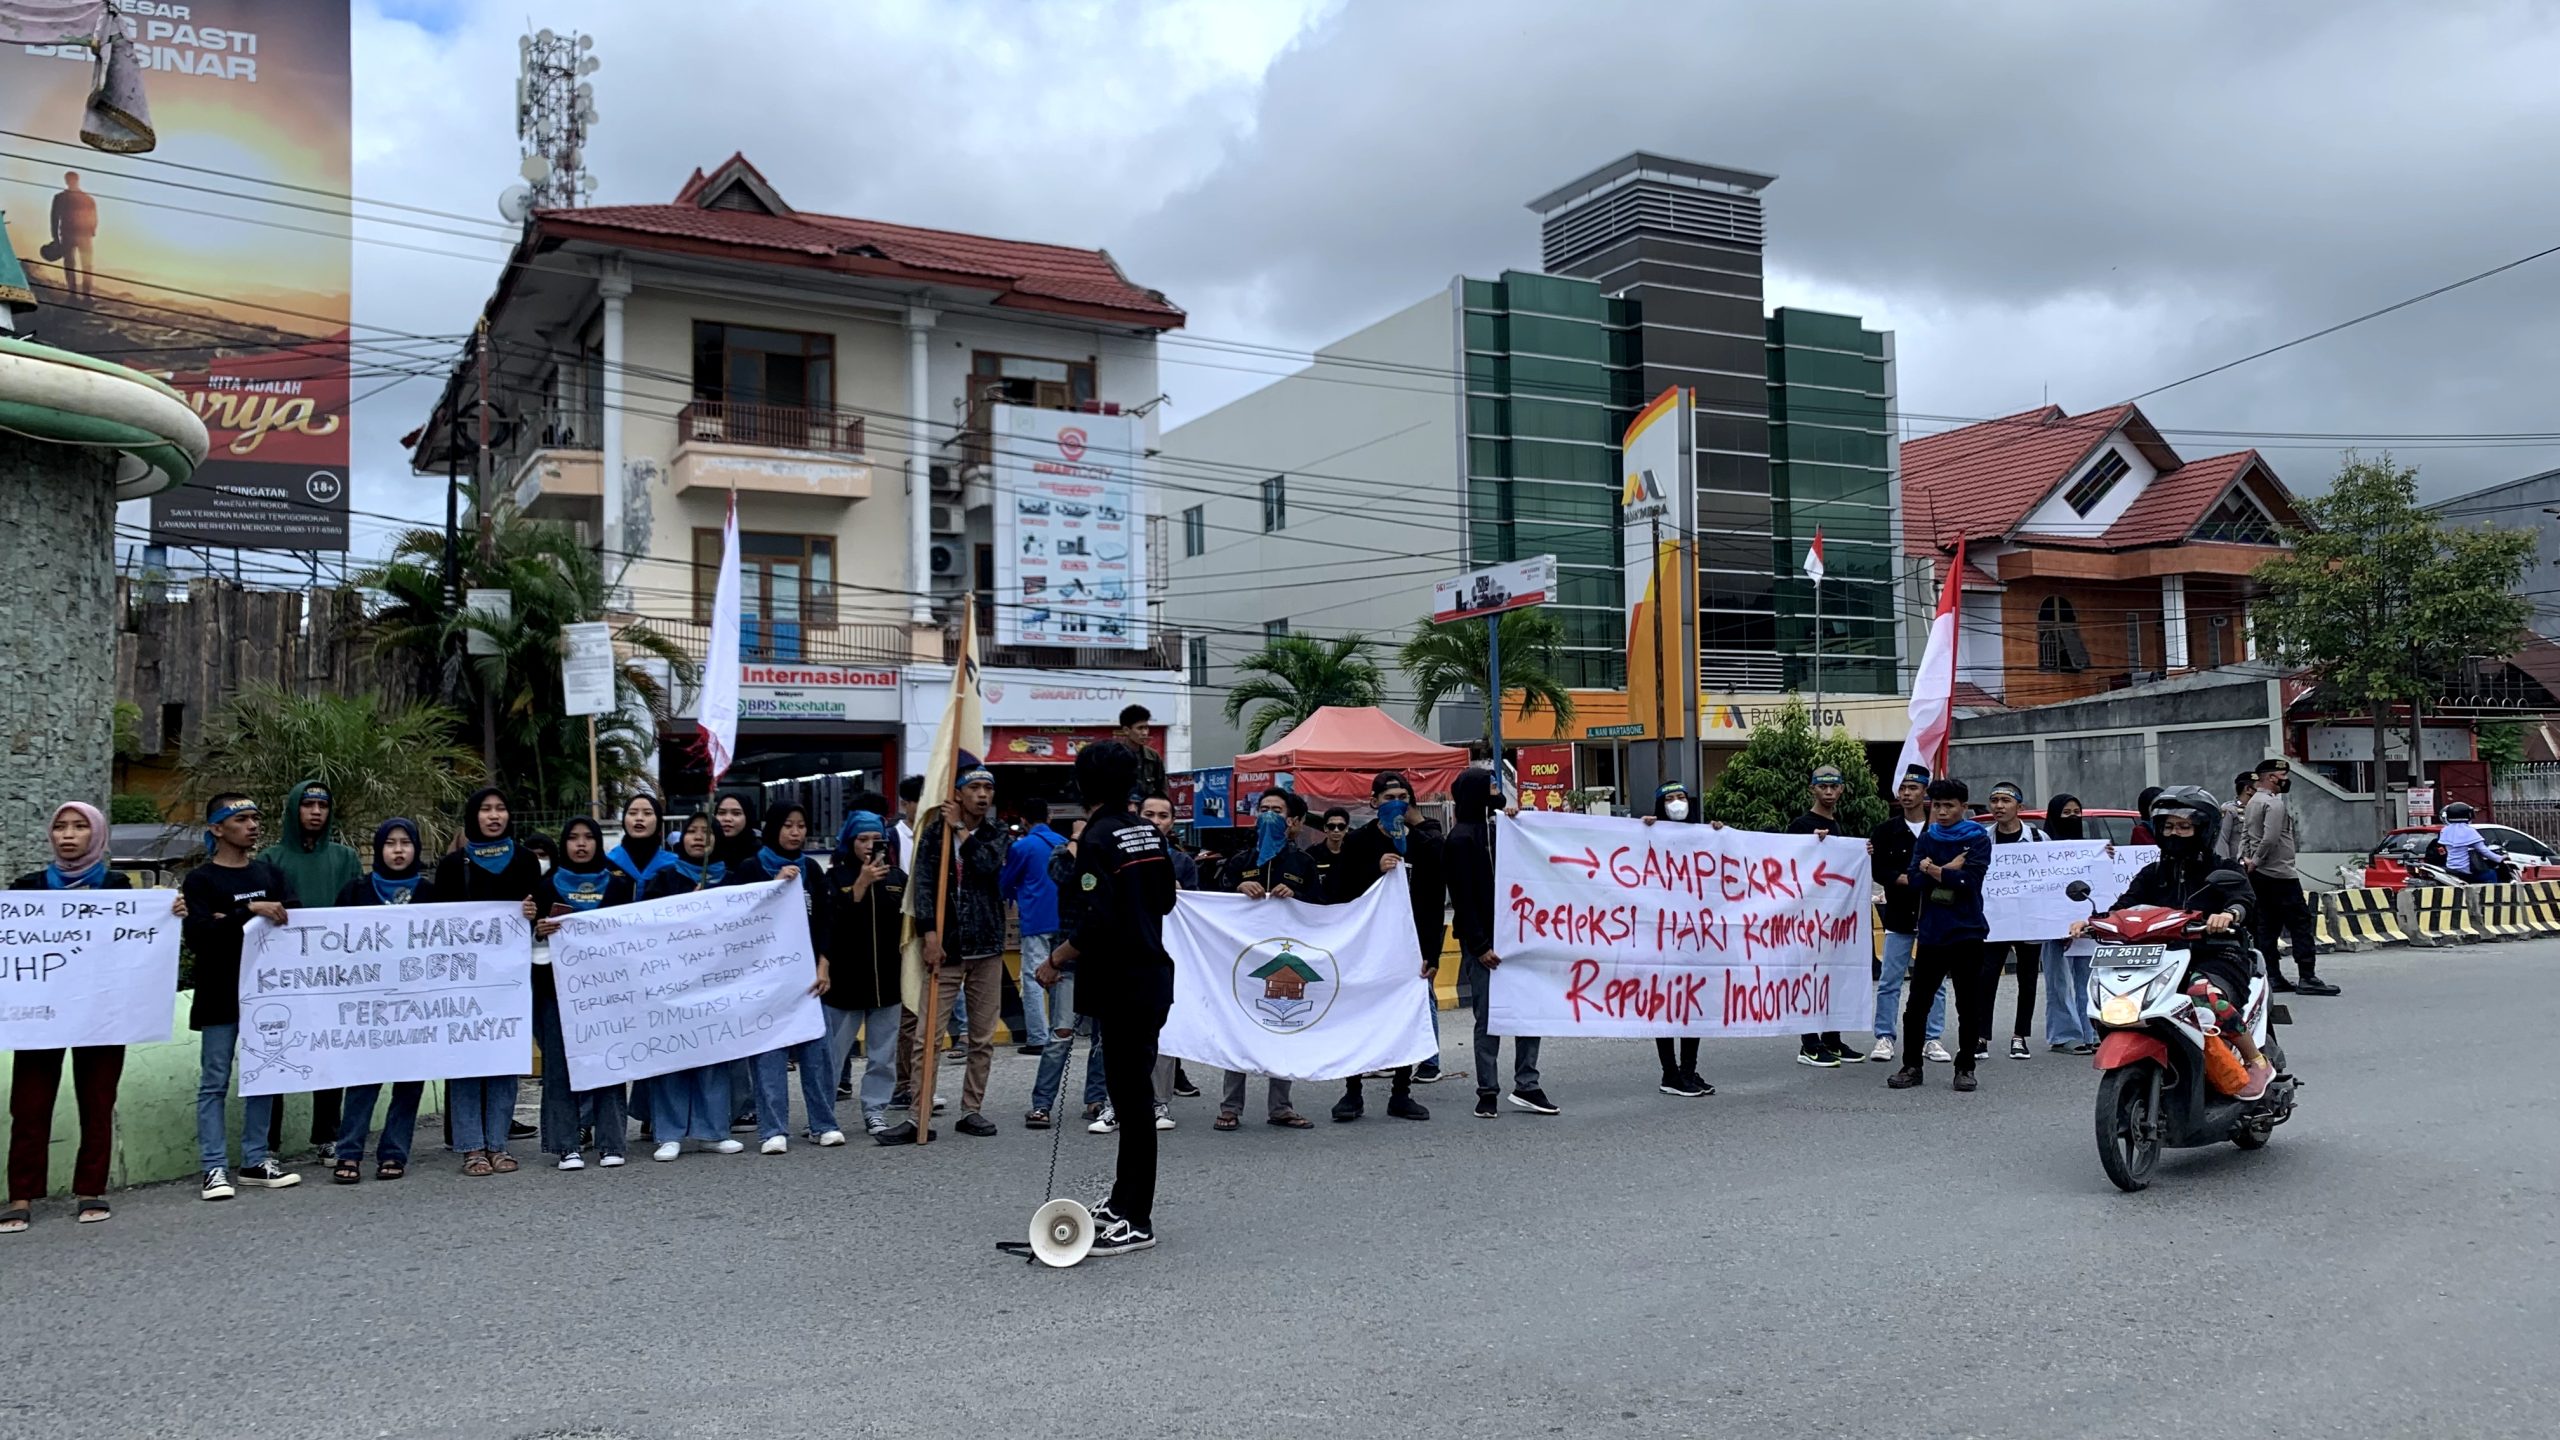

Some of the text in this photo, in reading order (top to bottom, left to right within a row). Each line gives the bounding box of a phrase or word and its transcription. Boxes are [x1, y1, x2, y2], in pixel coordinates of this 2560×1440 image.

[147, 20, 257, 54] PASTI
[208, 375, 241, 391] KITA
[312, 480, 335, 493] 18+
[742, 664, 897, 686] Internasional
[748, 700, 846, 712] BPJS Kesehatan
[1806, 708, 1846, 726] EGA
[1531, 764, 1560, 776] PROMO
[1609, 839, 1804, 901] GAMPEKRI
[1995, 854, 2039, 866] KEPADA
[283, 922, 394, 957] TOLAK
[407, 917, 503, 949] HARGA
[560, 938, 658, 967] GORONTALO
[667, 928, 707, 945] AGAR
[2096, 946, 2164, 958] DM 2611 JE
[257, 953, 478, 994] KENAIKAN BBM
[568, 968, 629, 994] OKNUM
[639, 961, 672, 977] APH
[645, 980, 690, 1000] KASUS
[702, 967, 745, 988] FERDI
[752, 951, 803, 974] SAMBO
[338, 996, 483, 1027] PERTAMINA
[1723, 964, 1830, 1027] Indonesia
[447, 1016, 523, 1045] RAKYAT
[576, 1016, 638, 1044] UNTUK
[650, 995, 731, 1029] DIMUTASI
[605, 1012, 774, 1071] GORONTALO
